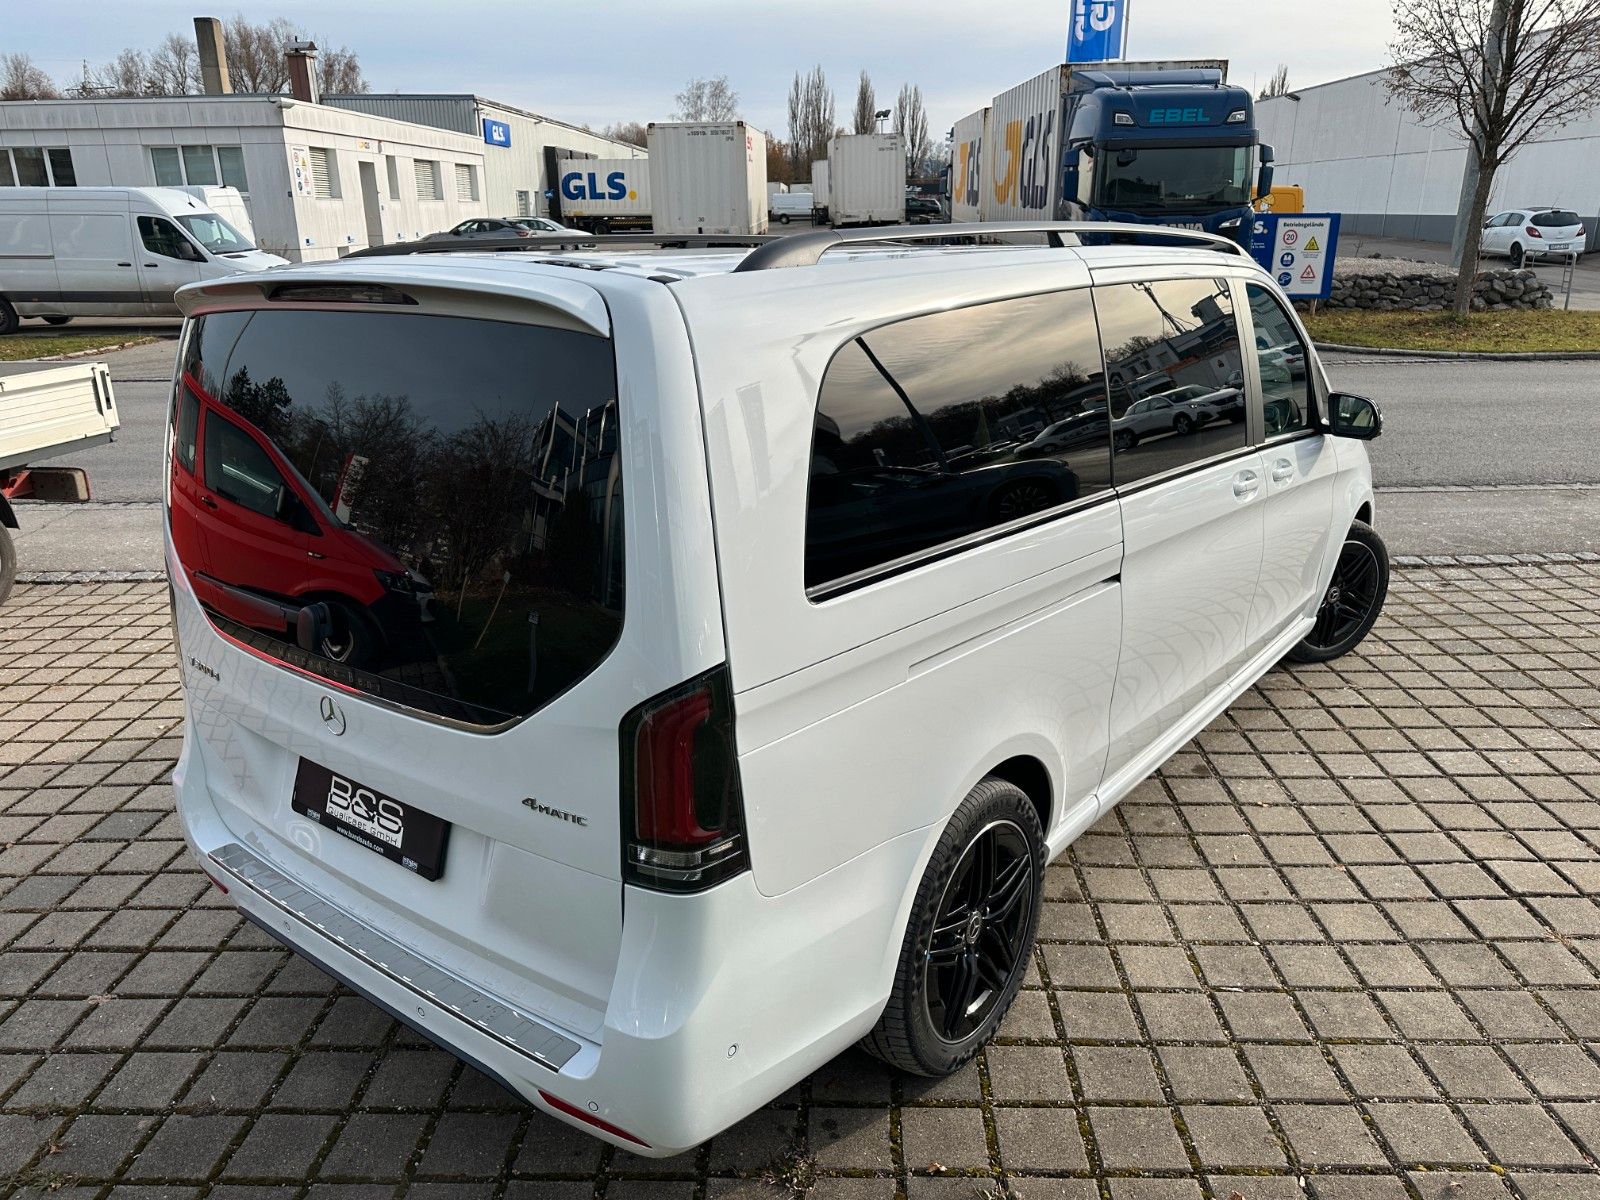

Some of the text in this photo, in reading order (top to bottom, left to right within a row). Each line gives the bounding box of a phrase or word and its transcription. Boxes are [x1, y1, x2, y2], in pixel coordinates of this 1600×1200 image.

[1147, 108, 1211, 124] EBEL
[1283, 221, 1325, 229] Betriebsgelände
[1286, 233, 1295, 241] 20
[330, 775, 404, 835] B&S
[370, 826, 398, 846] GmbH
